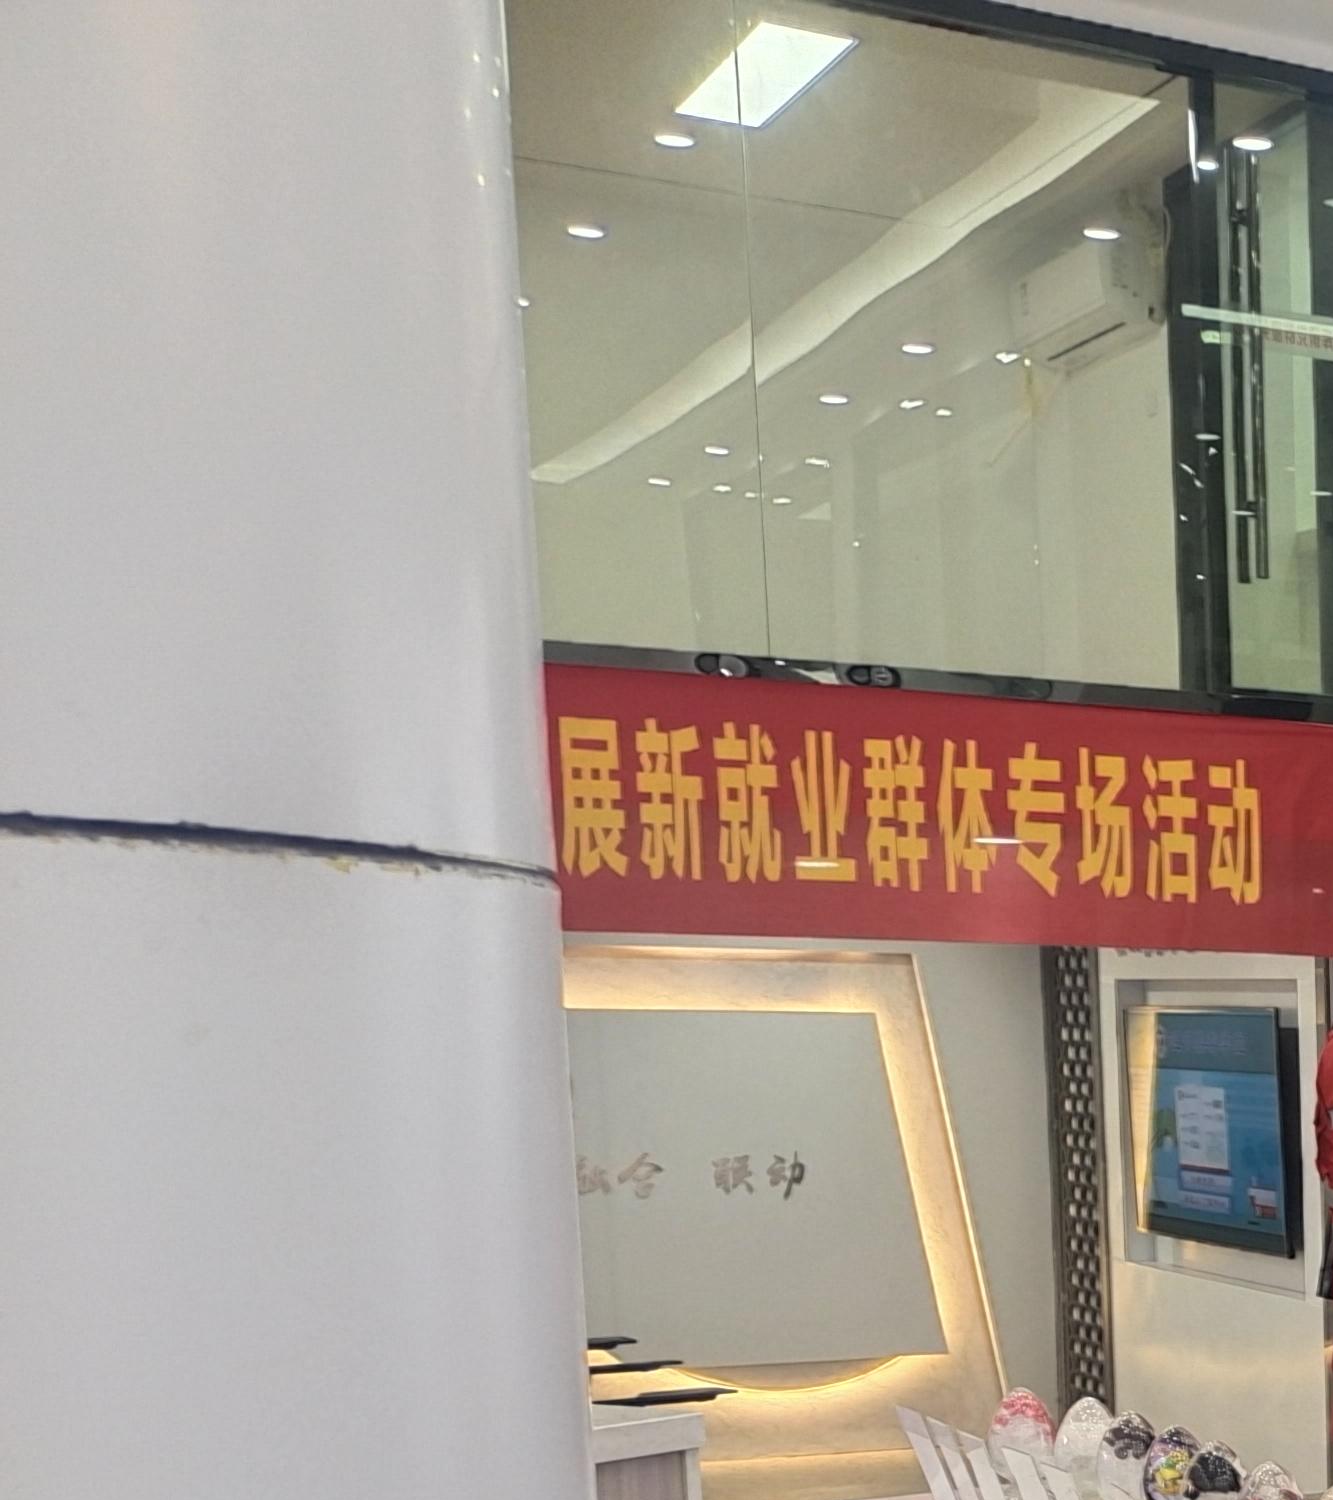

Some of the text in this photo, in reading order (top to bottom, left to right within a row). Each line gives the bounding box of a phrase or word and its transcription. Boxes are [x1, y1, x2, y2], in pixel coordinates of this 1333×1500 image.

[558, 716, 1262, 905] 展新就业群体专场活动
